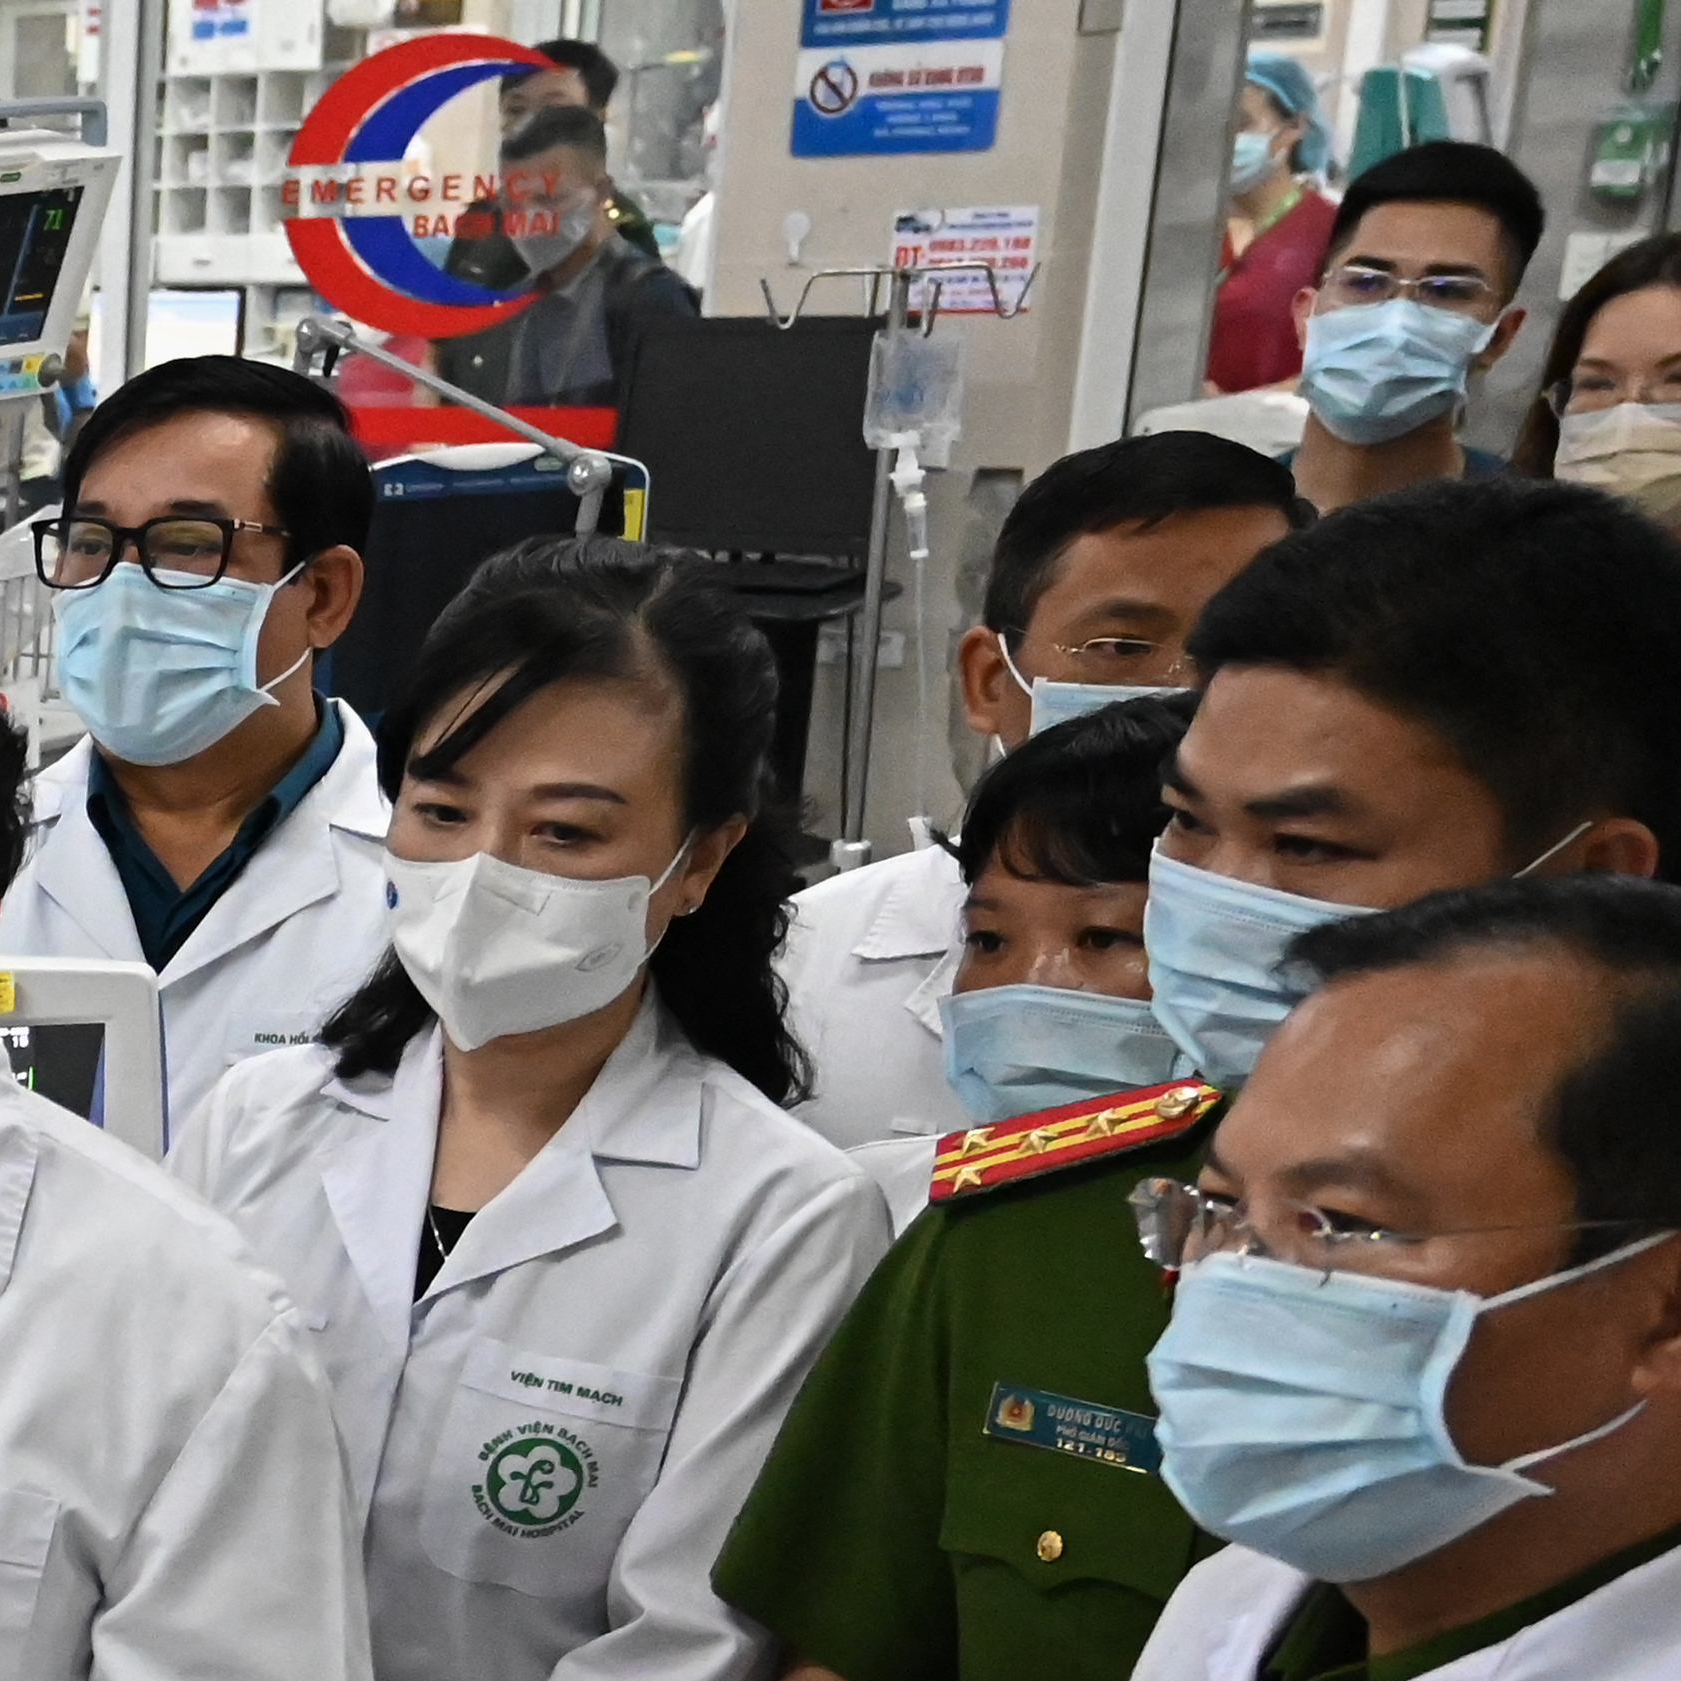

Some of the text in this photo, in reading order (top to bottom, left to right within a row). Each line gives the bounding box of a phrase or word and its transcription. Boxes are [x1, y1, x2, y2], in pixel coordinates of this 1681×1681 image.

[282, 166, 561, 205] EMERGENCY
[502, 210, 560, 237] MAI
[254, 1032, 287, 1045] KHOA
[510, 1370, 624, 1407] VIỆN TIM MẠCH
[477, 1430, 513, 1461] BỆNH
[517, 1421, 554, 1436] VIỆN
[588, 1461, 600, 1488] MAI
[471, 1484, 585, 1539] BACH MAI HOSPITAL
